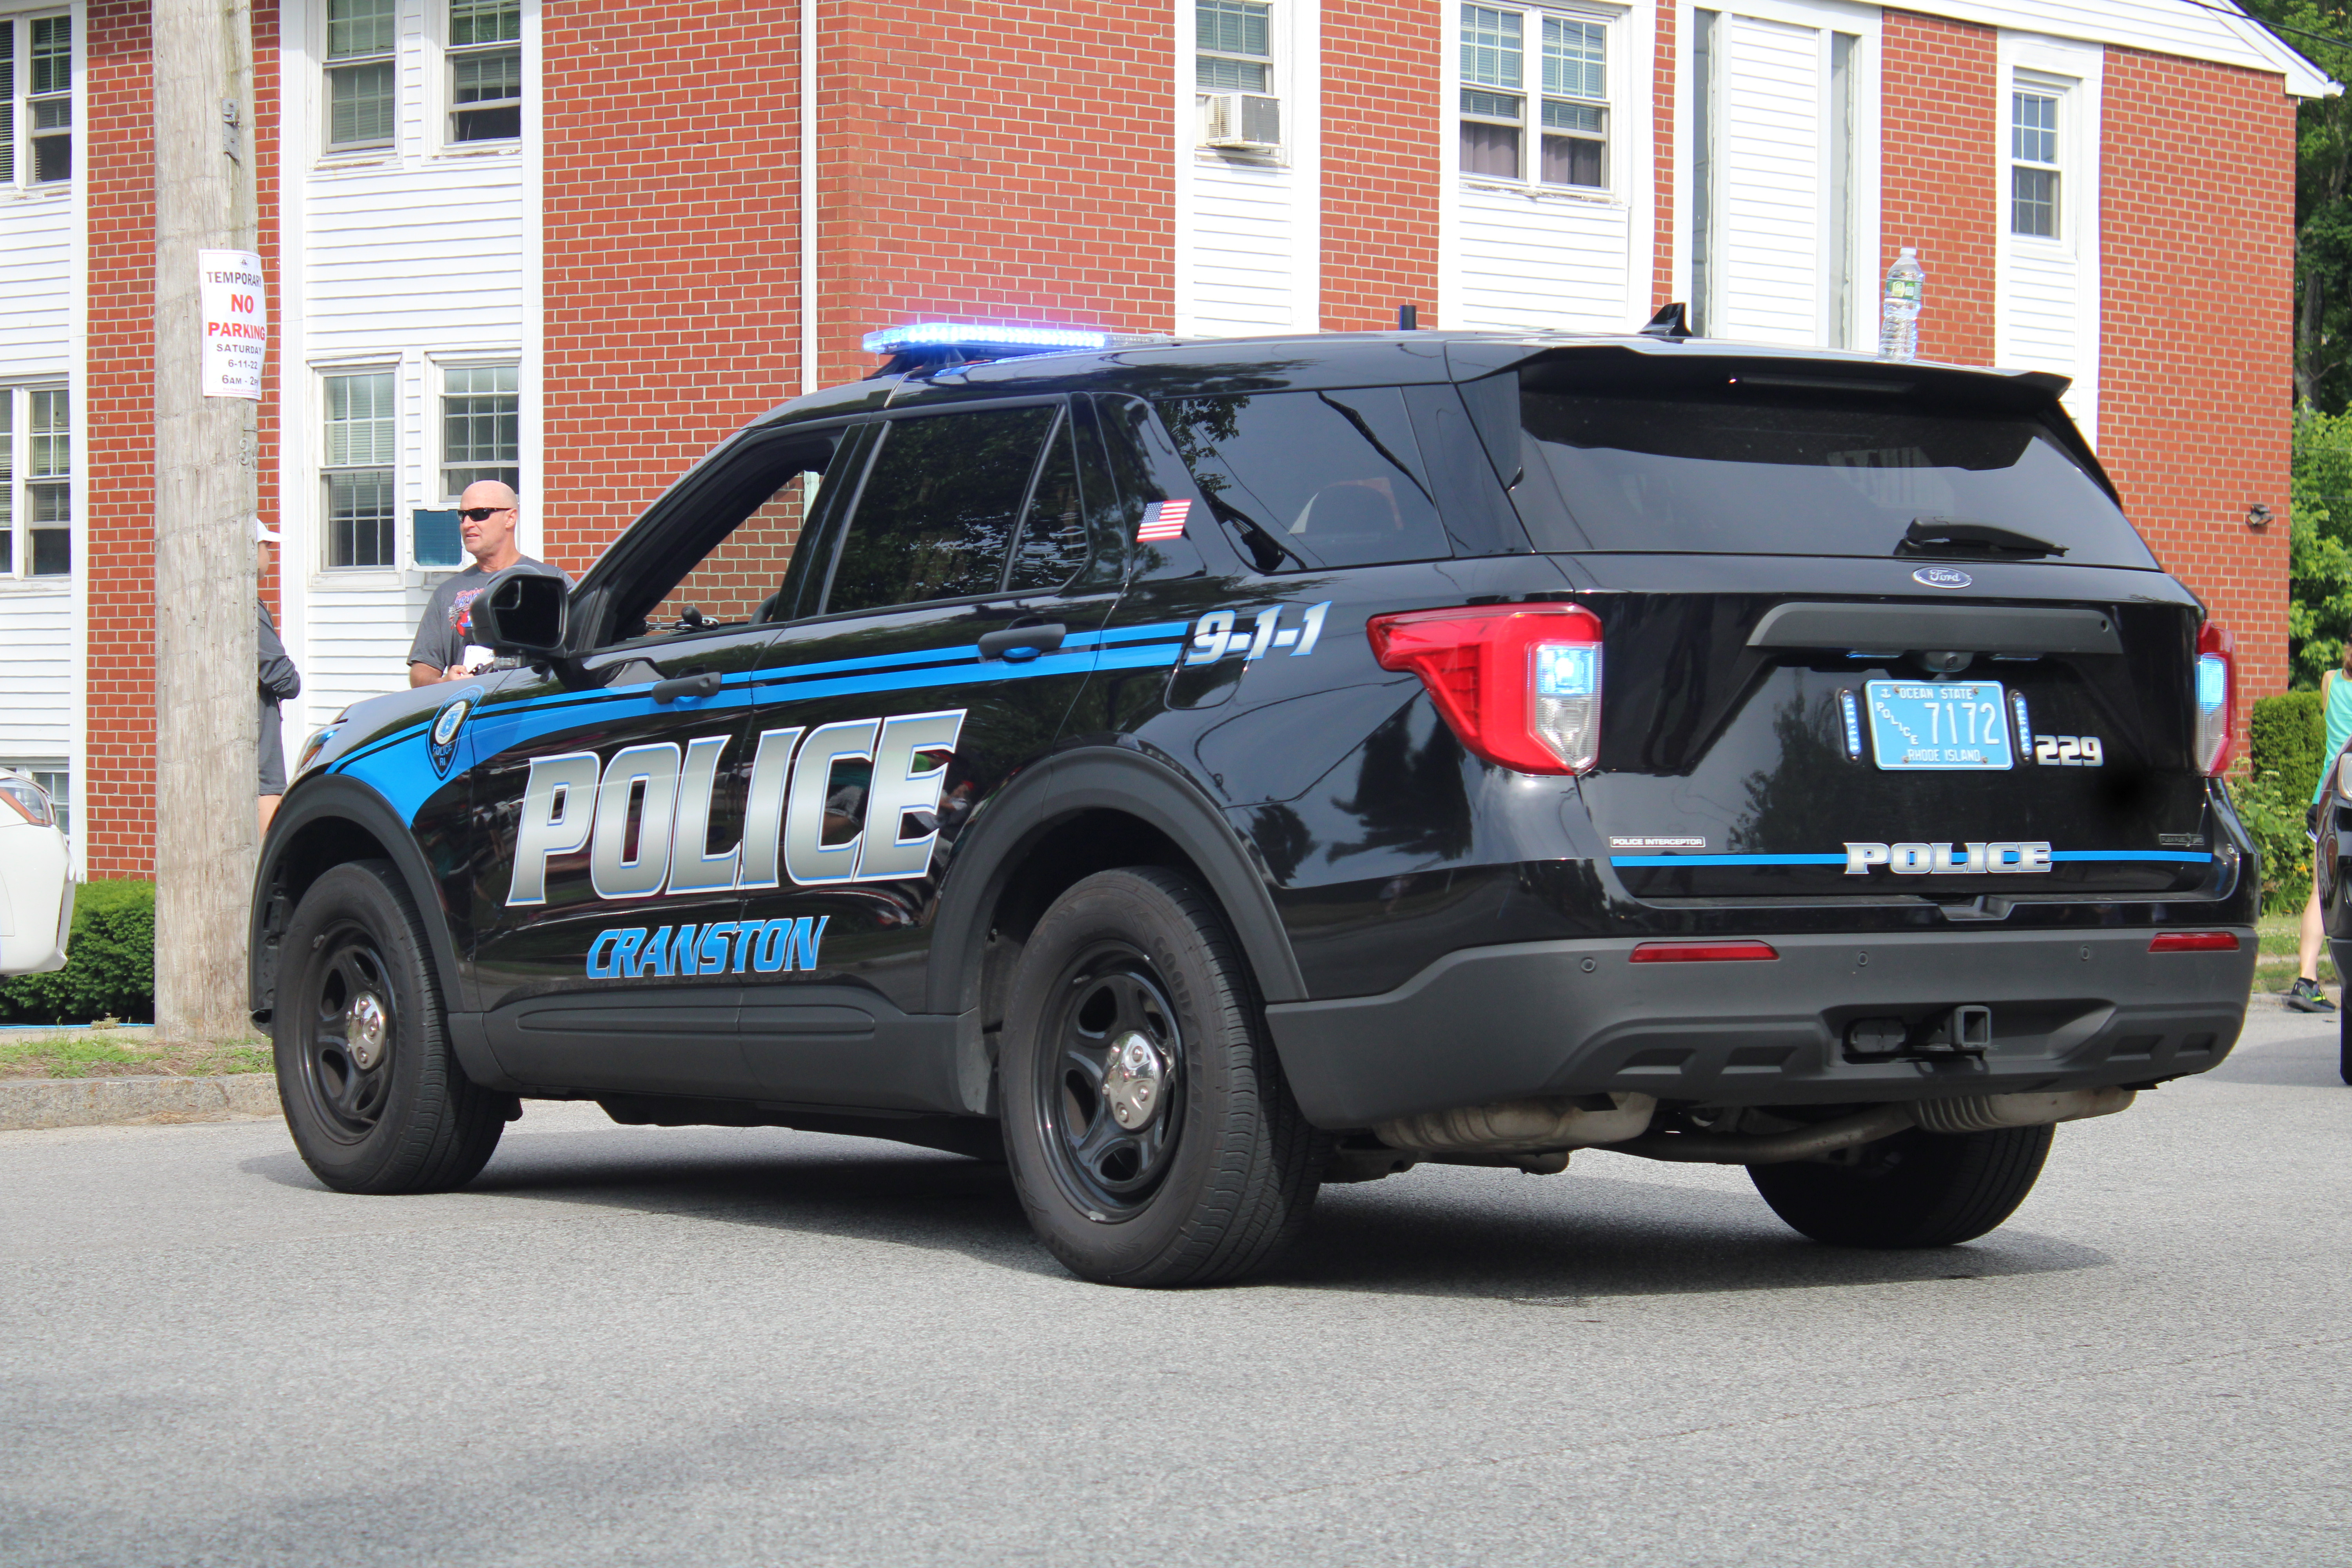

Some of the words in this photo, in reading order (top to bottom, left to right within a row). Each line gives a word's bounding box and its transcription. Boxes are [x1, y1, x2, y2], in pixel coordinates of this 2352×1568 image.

[206, 272, 261, 287] TEMPORARY
[231, 294, 254, 314] NO
[208, 322, 265, 341] PARKING
[216, 344, 261, 355] SATURDAY
[228, 359, 258, 369] 6-11-22
[222, 374, 241, 384] 6AM
[1929, 569, 1961, 582] Ford
[1184, 601, 1332, 666] 9-1-1
[1899, 688, 1934, 699] OCEAN
[1940, 688, 1973, 700] STATE
[1875, 702, 1919, 745] POLICE
[1924, 702, 2000, 745] 7172
[433, 743, 452, 756] POLICE
[1907, 749, 1940, 762] RHODE
[1944, 749, 1981, 762] ISLAND
[2034, 735, 2103, 766] 229
[439, 757, 446, 766] RI
[505, 708, 967, 906] POLICE
[1842, 842, 2053, 875] POLICE
[586, 915, 830, 979] CRANSTON
